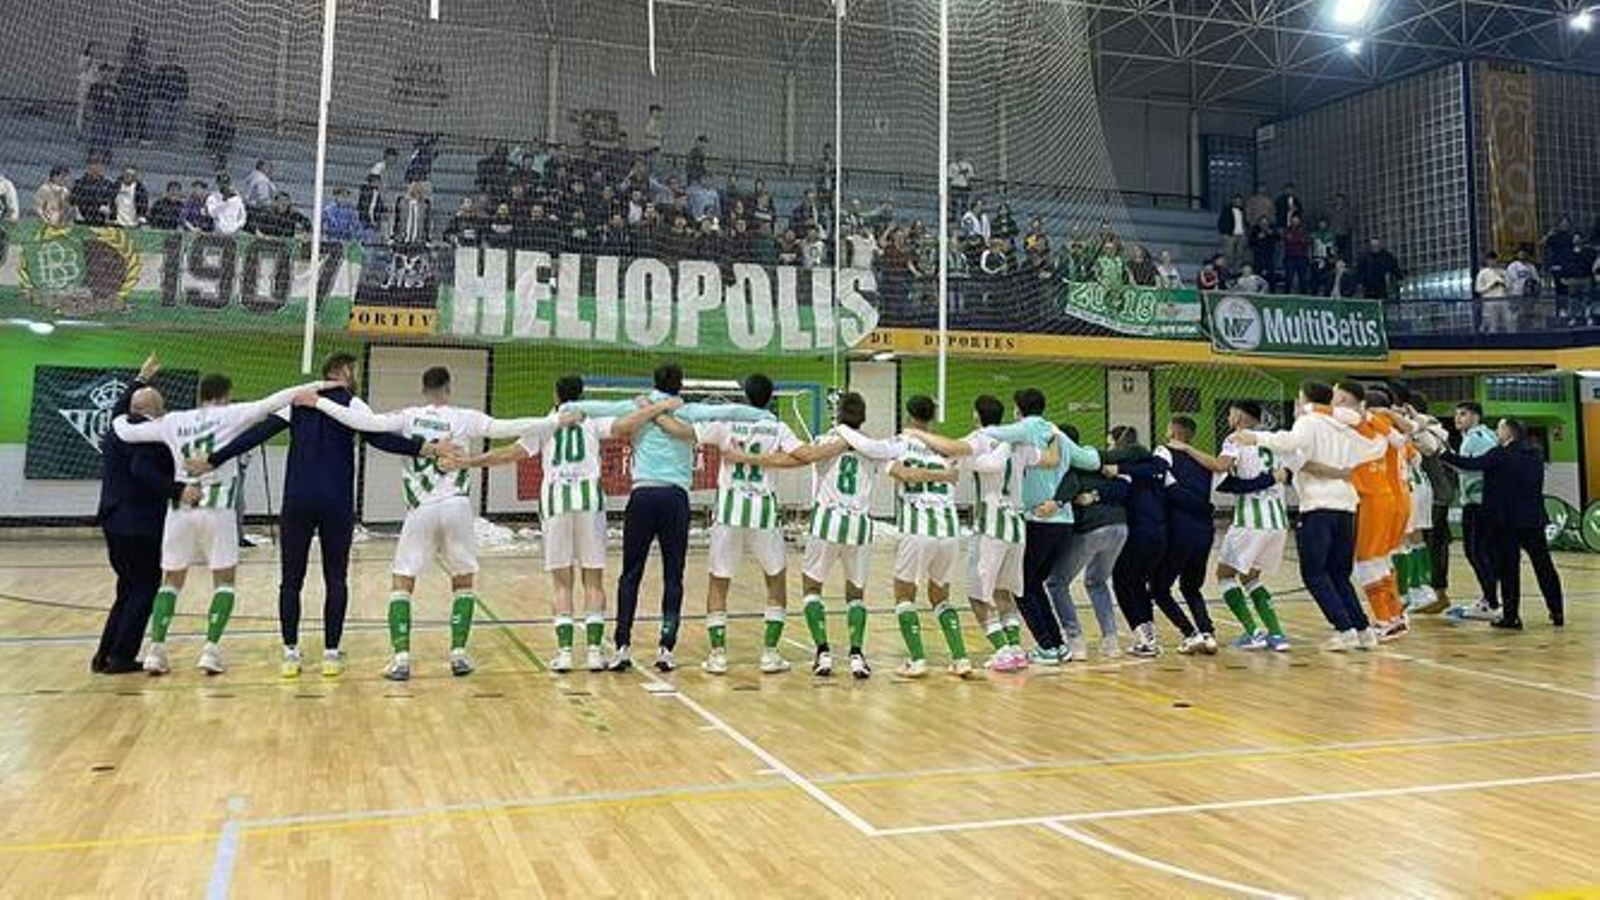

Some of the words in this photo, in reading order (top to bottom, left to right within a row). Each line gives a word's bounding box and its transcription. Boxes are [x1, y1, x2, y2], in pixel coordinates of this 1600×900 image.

[161, 233, 345, 319] 1907
[451, 246, 881, 351] HELIOPOLIS
[871, 331, 892, 345] DE
[1262, 307, 1380, 347] MultiBetis
[551, 424, 586, 467] 10
[837, 454, 859, 497] 8
